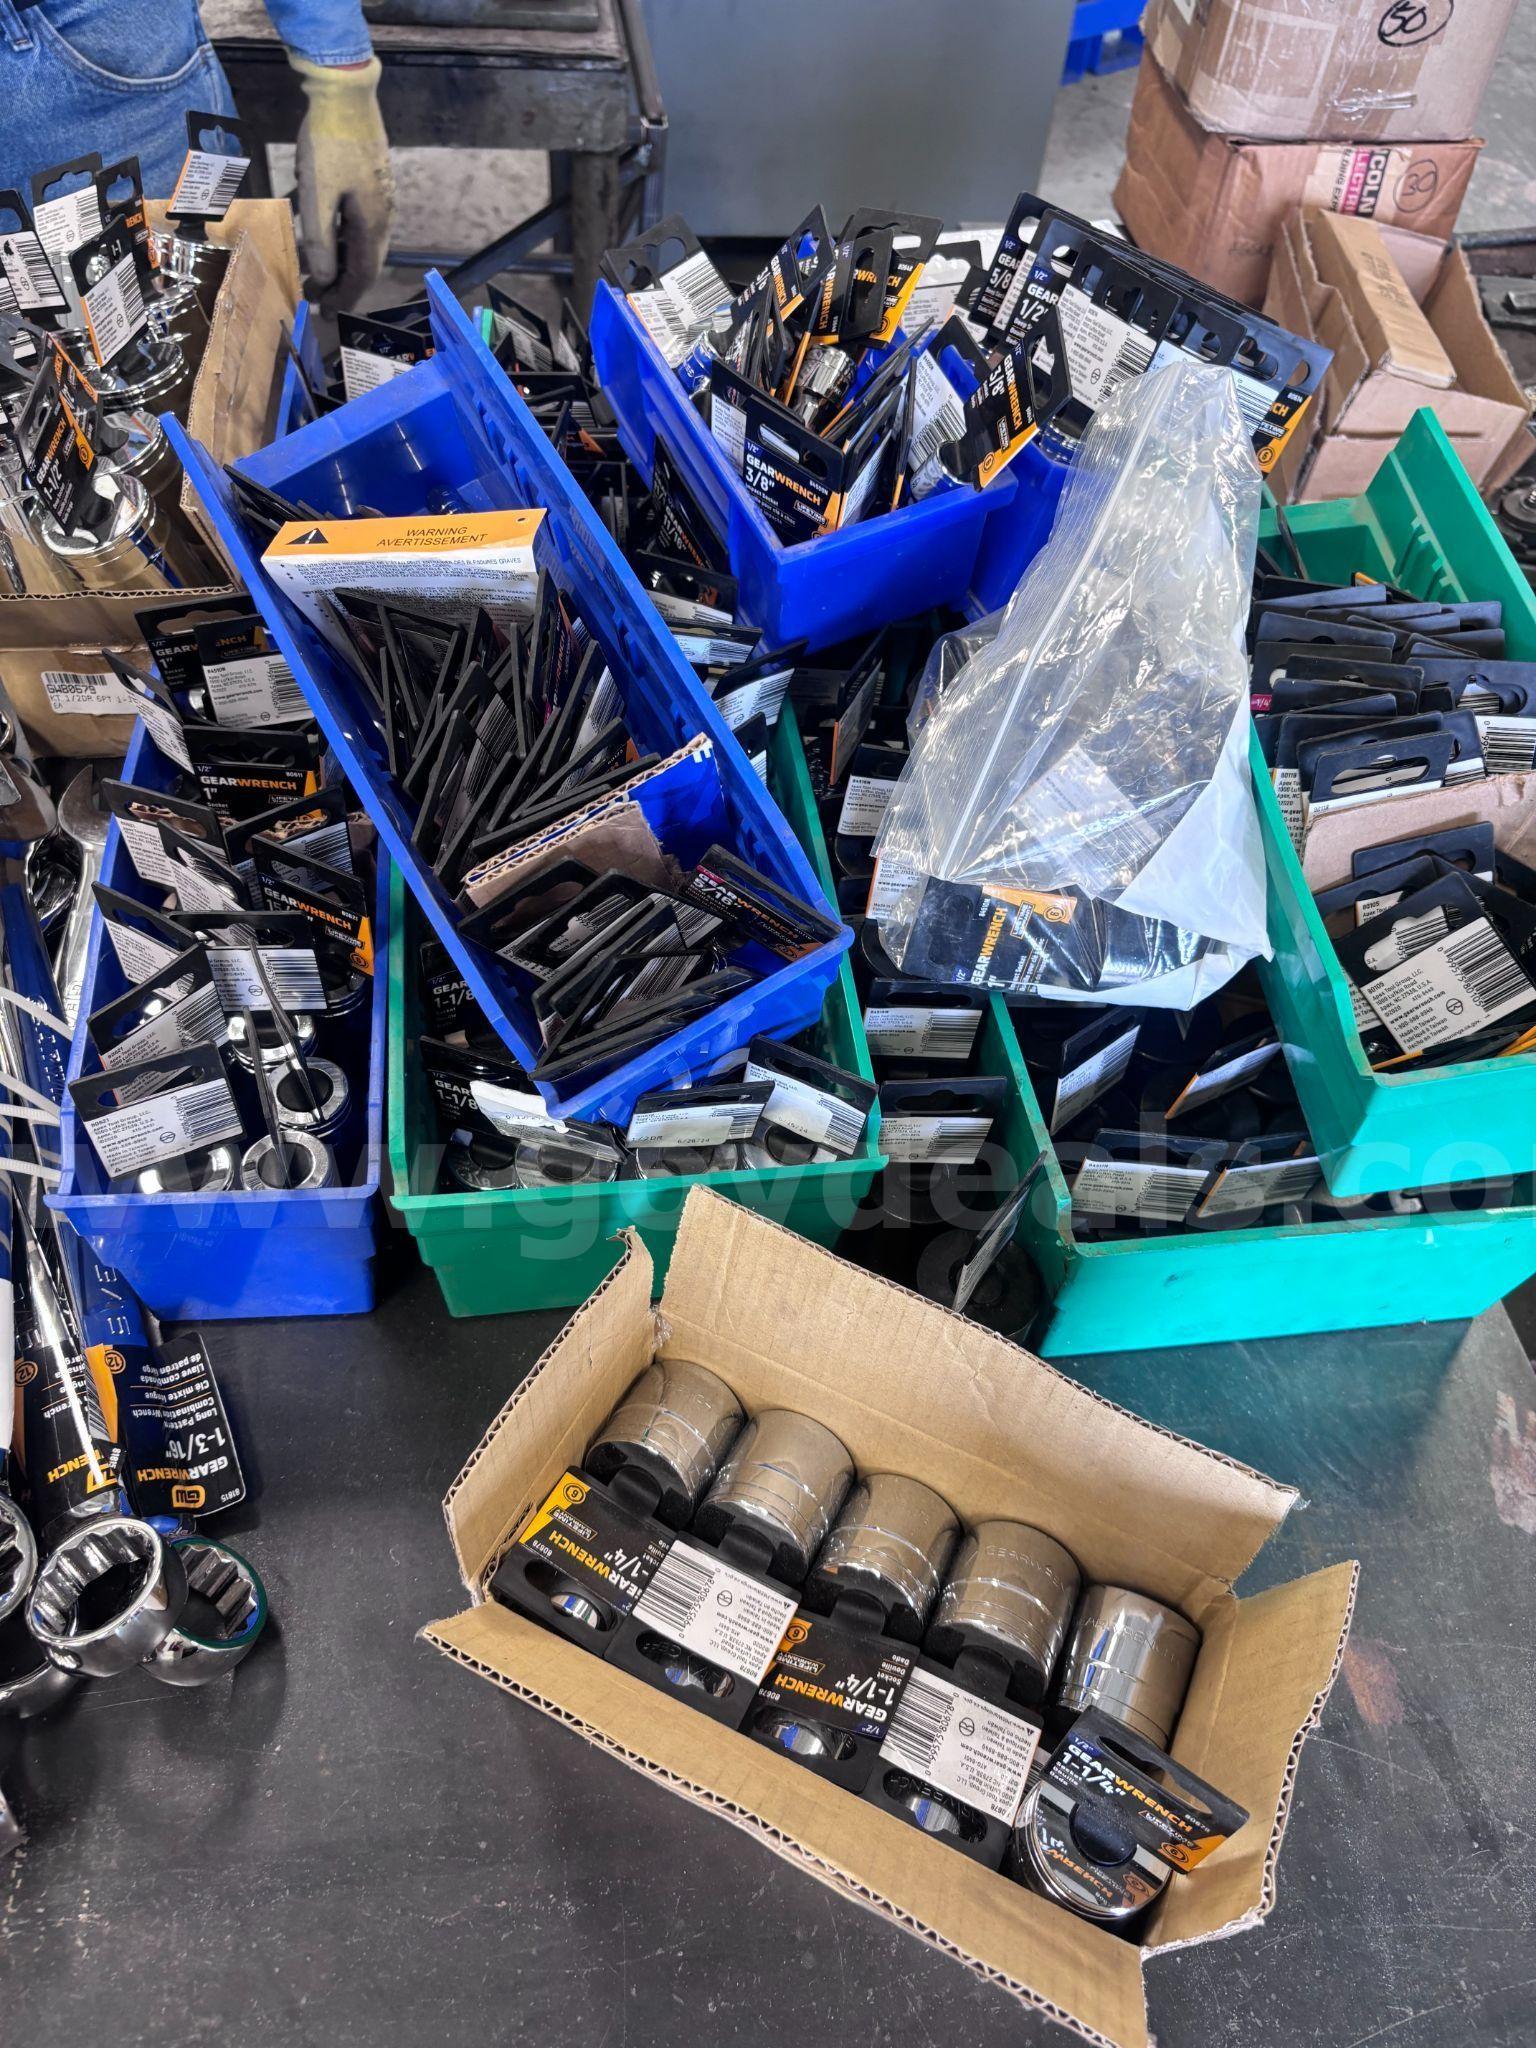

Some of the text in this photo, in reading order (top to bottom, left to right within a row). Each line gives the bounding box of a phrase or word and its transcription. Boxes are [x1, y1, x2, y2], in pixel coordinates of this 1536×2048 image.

[1391, 1, 1428, 34] 50
[990, 268, 1011, 290] 5/8
[1034, 268, 1048, 281] 1/2"
[1027, 283, 1060, 305] GEAR
[988, 364, 1005, 397] 3/8"
[1004, 353, 1023, 430] GEARWRENCH
[36, 418, 67, 485] GEARWRENCH
[747, 441, 759, 454] 1/2"
[745, 467, 775, 492] 3/8"
[746, 454, 821, 507] GEARWRENCH
[376, 533, 488, 547] AVERTISSEMENT
[407, 526, 468, 537] WARNING
[159, 658, 173, 669] 1"
[198, 765, 212, 773] 1/2"
[200, 775, 297, 790] GEARWRENCH
[203, 788, 218, 800] 1"
[261, 877, 276, 886] 1/2"
[264, 887, 352, 930] GEARWRENCH
[698, 873, 798, 939] GEARWRENCH
[1362, 900, 1380, 910] 80105
[970, 906, 1008, 985] GEARWRENCH
[955, 968, 966, 982] 1/2"
[988, 974, 1006, 988] 1"
[1367, 981, 1385, 995] 80105
[1372, 968, 1424, 1001] Apex Tool Group, LLC.
[1375, 979, 1418, 1008] 1000 Lufkin Road
[1394, 996, 1402, 1004] NC
[1418, 979, 1433, 991] U.S.A.
[1462, 982, 1484, 1007] 80105
[1389, 991, 1446, 1024] www.gearwrench.com
[1399, 1028, 1413, 1039] Made
[1418, 1015, 1437, 1028] Taiwan
[1428, 1017, 1448, 1030] Taiwan
[437, 1089, 478, 1110] 1-1/8
[107, 1357, 120, 1368] 12
[160, 1353, 202, 1372] de patrón
[19, 1368, 31, 1380] 12
[140, 1363, 205, 1385] Llave combinada
[168, 1379, 210, 1401] Clé mixte
[132, 1396, 215, 1418] Combination Wrench
[195, 1407, 218, 1422] Long
[166, 1427, 226, 1462] 1-3/16"
[137, 1455, 229, 1482] GEARWRENCH
[176, 1489, 201, 1503] GW
[220, 1487, 241, 1503] 81815
[571, 1490, 578, 1498] 6
[532, 1539, 553, 1557] 80678
[684, 1602, 701, 1627] 99575
[699, 1578, 715, 1602] 80678
[716, 1611, 774, 1644] www.gearwrench.com
[882, 1662, 906, 1675] Douille
[892, 1654, 910, 1666] Dado
[739, 1664, 758, 1679] 80678
[876, 1671, 902, 1686] Socket
[758, 1688, 781, 1702] 80678
[774, 1673, 888, 1722] GEARWRENCH
[835, 1673, 895, 1706] 1-1/4"
[861, 1723, 880, 1734] 1/2"
[929, 1733, 944, 1761] 99575
[940, 1705, 955, 1731] 80678
[982, 1726, 1002, 1740] Taiwan
[987, 1735, 1006, 1749] Taiwan
[1017, 1736, 1032, 1747] Hecho
[1074, 1737, 1095, 1752] 1/2"
[960, 1743, 1022, 1778] www.gearwrench.com
[1012, 1750, 1027, 1761] Made
[960, 1761, 975, 1772] U.S.A.
[1055, 1760, 1083, 1782] Socket
[1062, 1751, 1127, 1796] 1-1/4"
[968, 1773, 1001, 1795] Lufkin Road
[1049, 1771, 1069, 1787] Dado
[1053, 1766, 1079, 1786] Douille
[988, 1791, 1000, 1802] Tool
[1068, 1744, 1194, 1833] GEARWRENCH
[1171, 1848, 1178, 1856] 6
